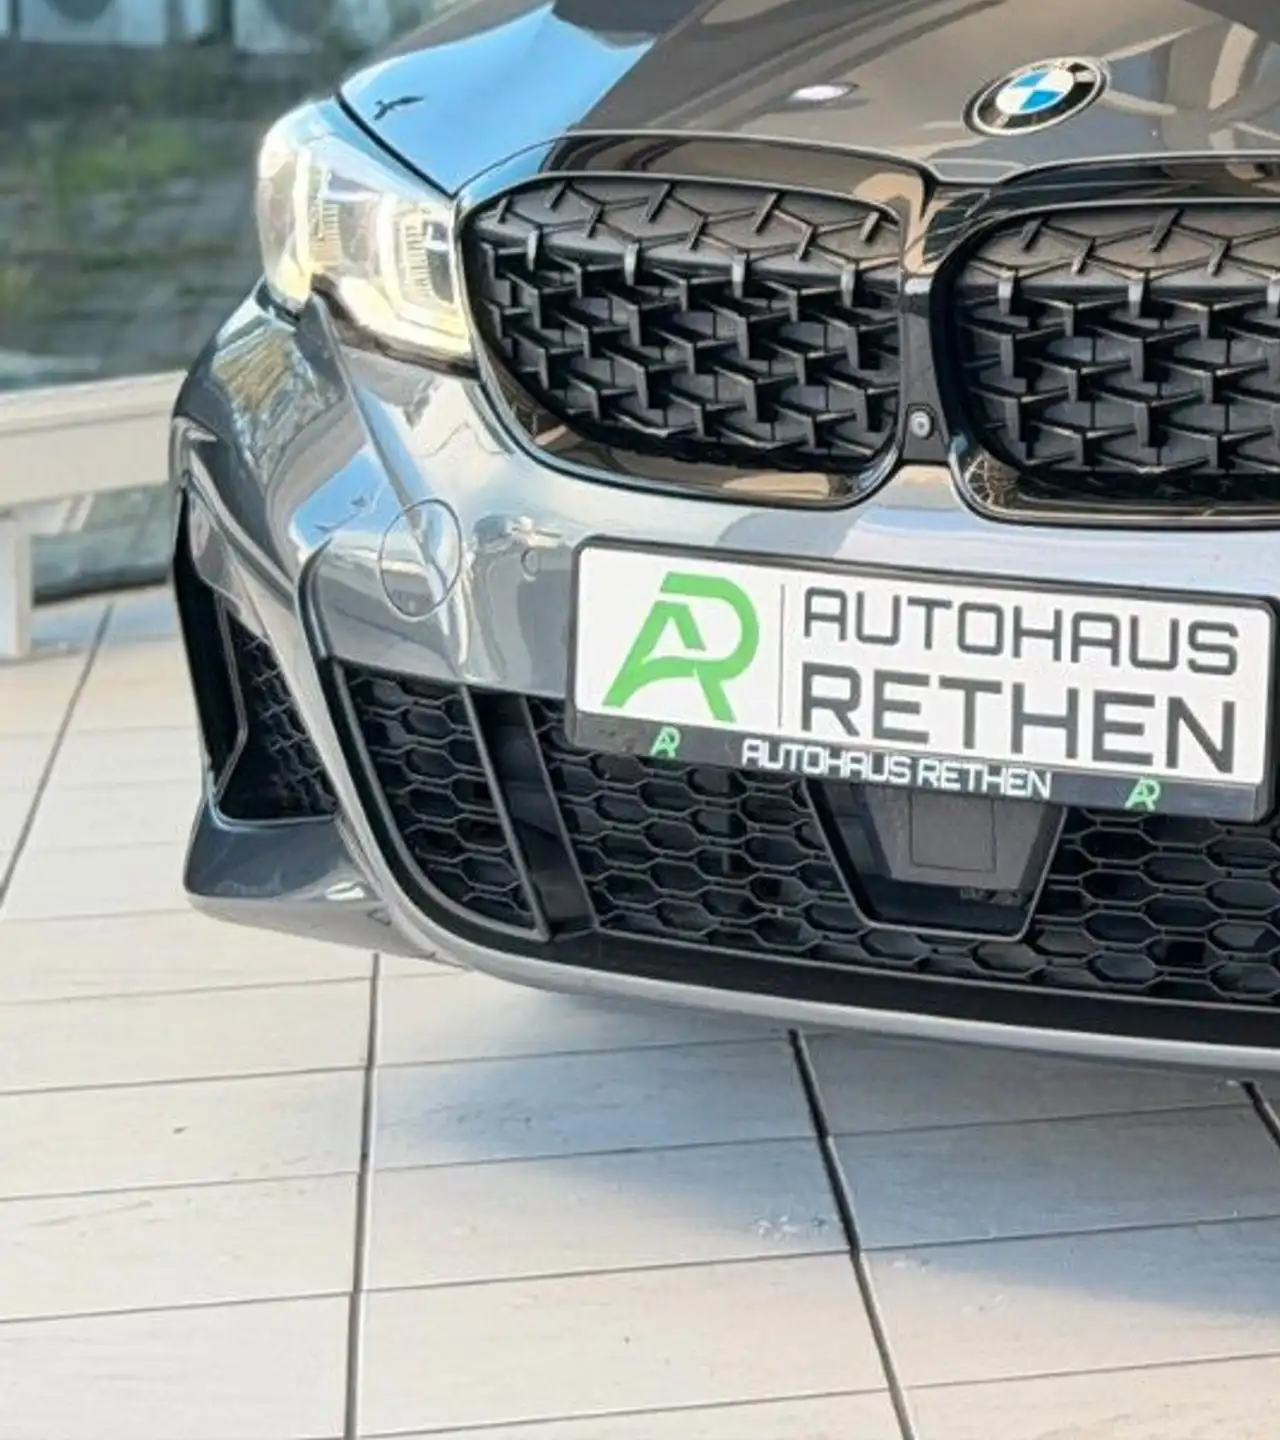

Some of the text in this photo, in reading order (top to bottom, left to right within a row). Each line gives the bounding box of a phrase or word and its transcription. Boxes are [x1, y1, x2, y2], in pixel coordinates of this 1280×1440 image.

[802, 586, 1239, 676] AUTOHAUS
[801, 662, 1236, 774] RETHEN
[742, 738, 911, 784] AUTOHAUS
[917, 757, 1051, 799] RETHEN
